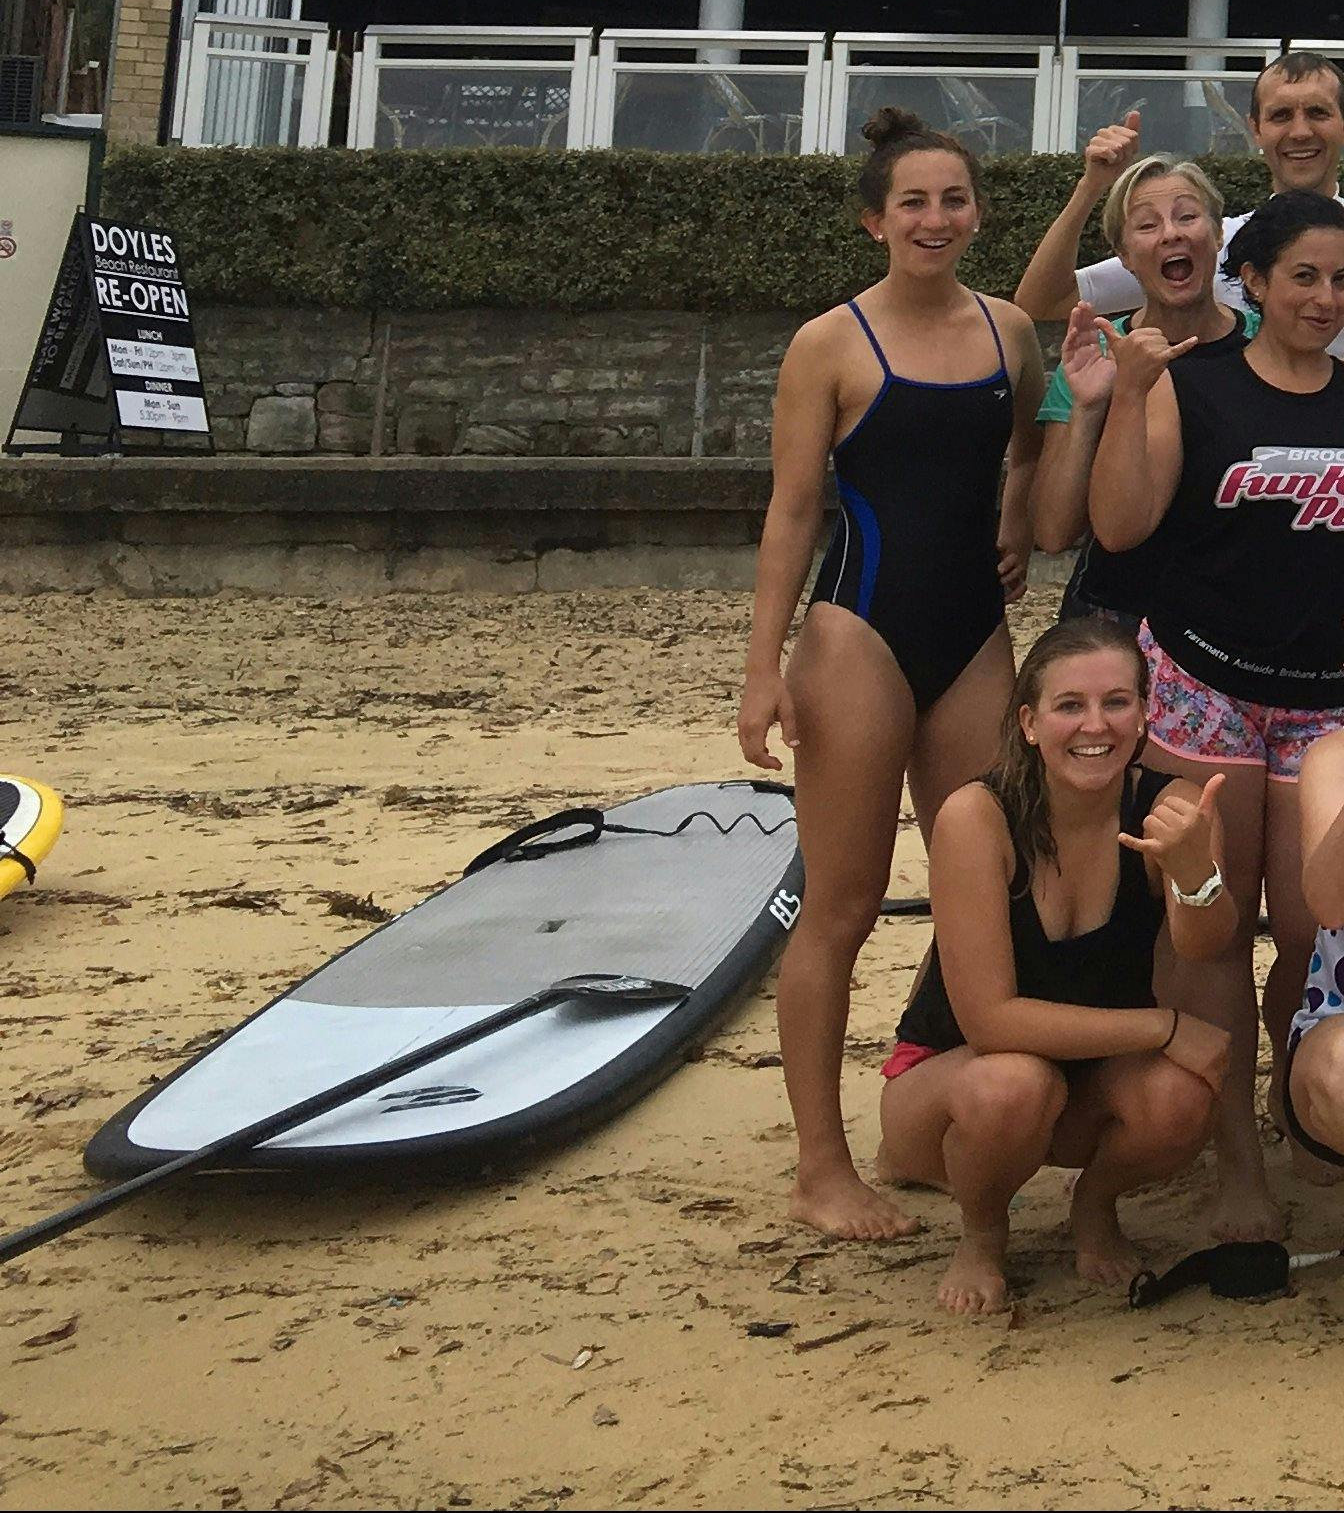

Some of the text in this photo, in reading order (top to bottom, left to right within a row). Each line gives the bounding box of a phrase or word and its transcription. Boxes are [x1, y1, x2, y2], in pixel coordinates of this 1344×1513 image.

[91, 222, 176, 264] DOYLES
[94, 254, 128, 272] Beach
[128, 260, 179, 280] Restaurant
[95, 276, 189, 316] RE-OPEN
[137, 329, 163, 341] LUNCH
[144, 381, 173, 392] DINNER
[1183, 628, 1229, 663] Parramatta
[1232, 658, 1275, 676] Adelaide
[1279, 667, 1317, 680] Brisbane
